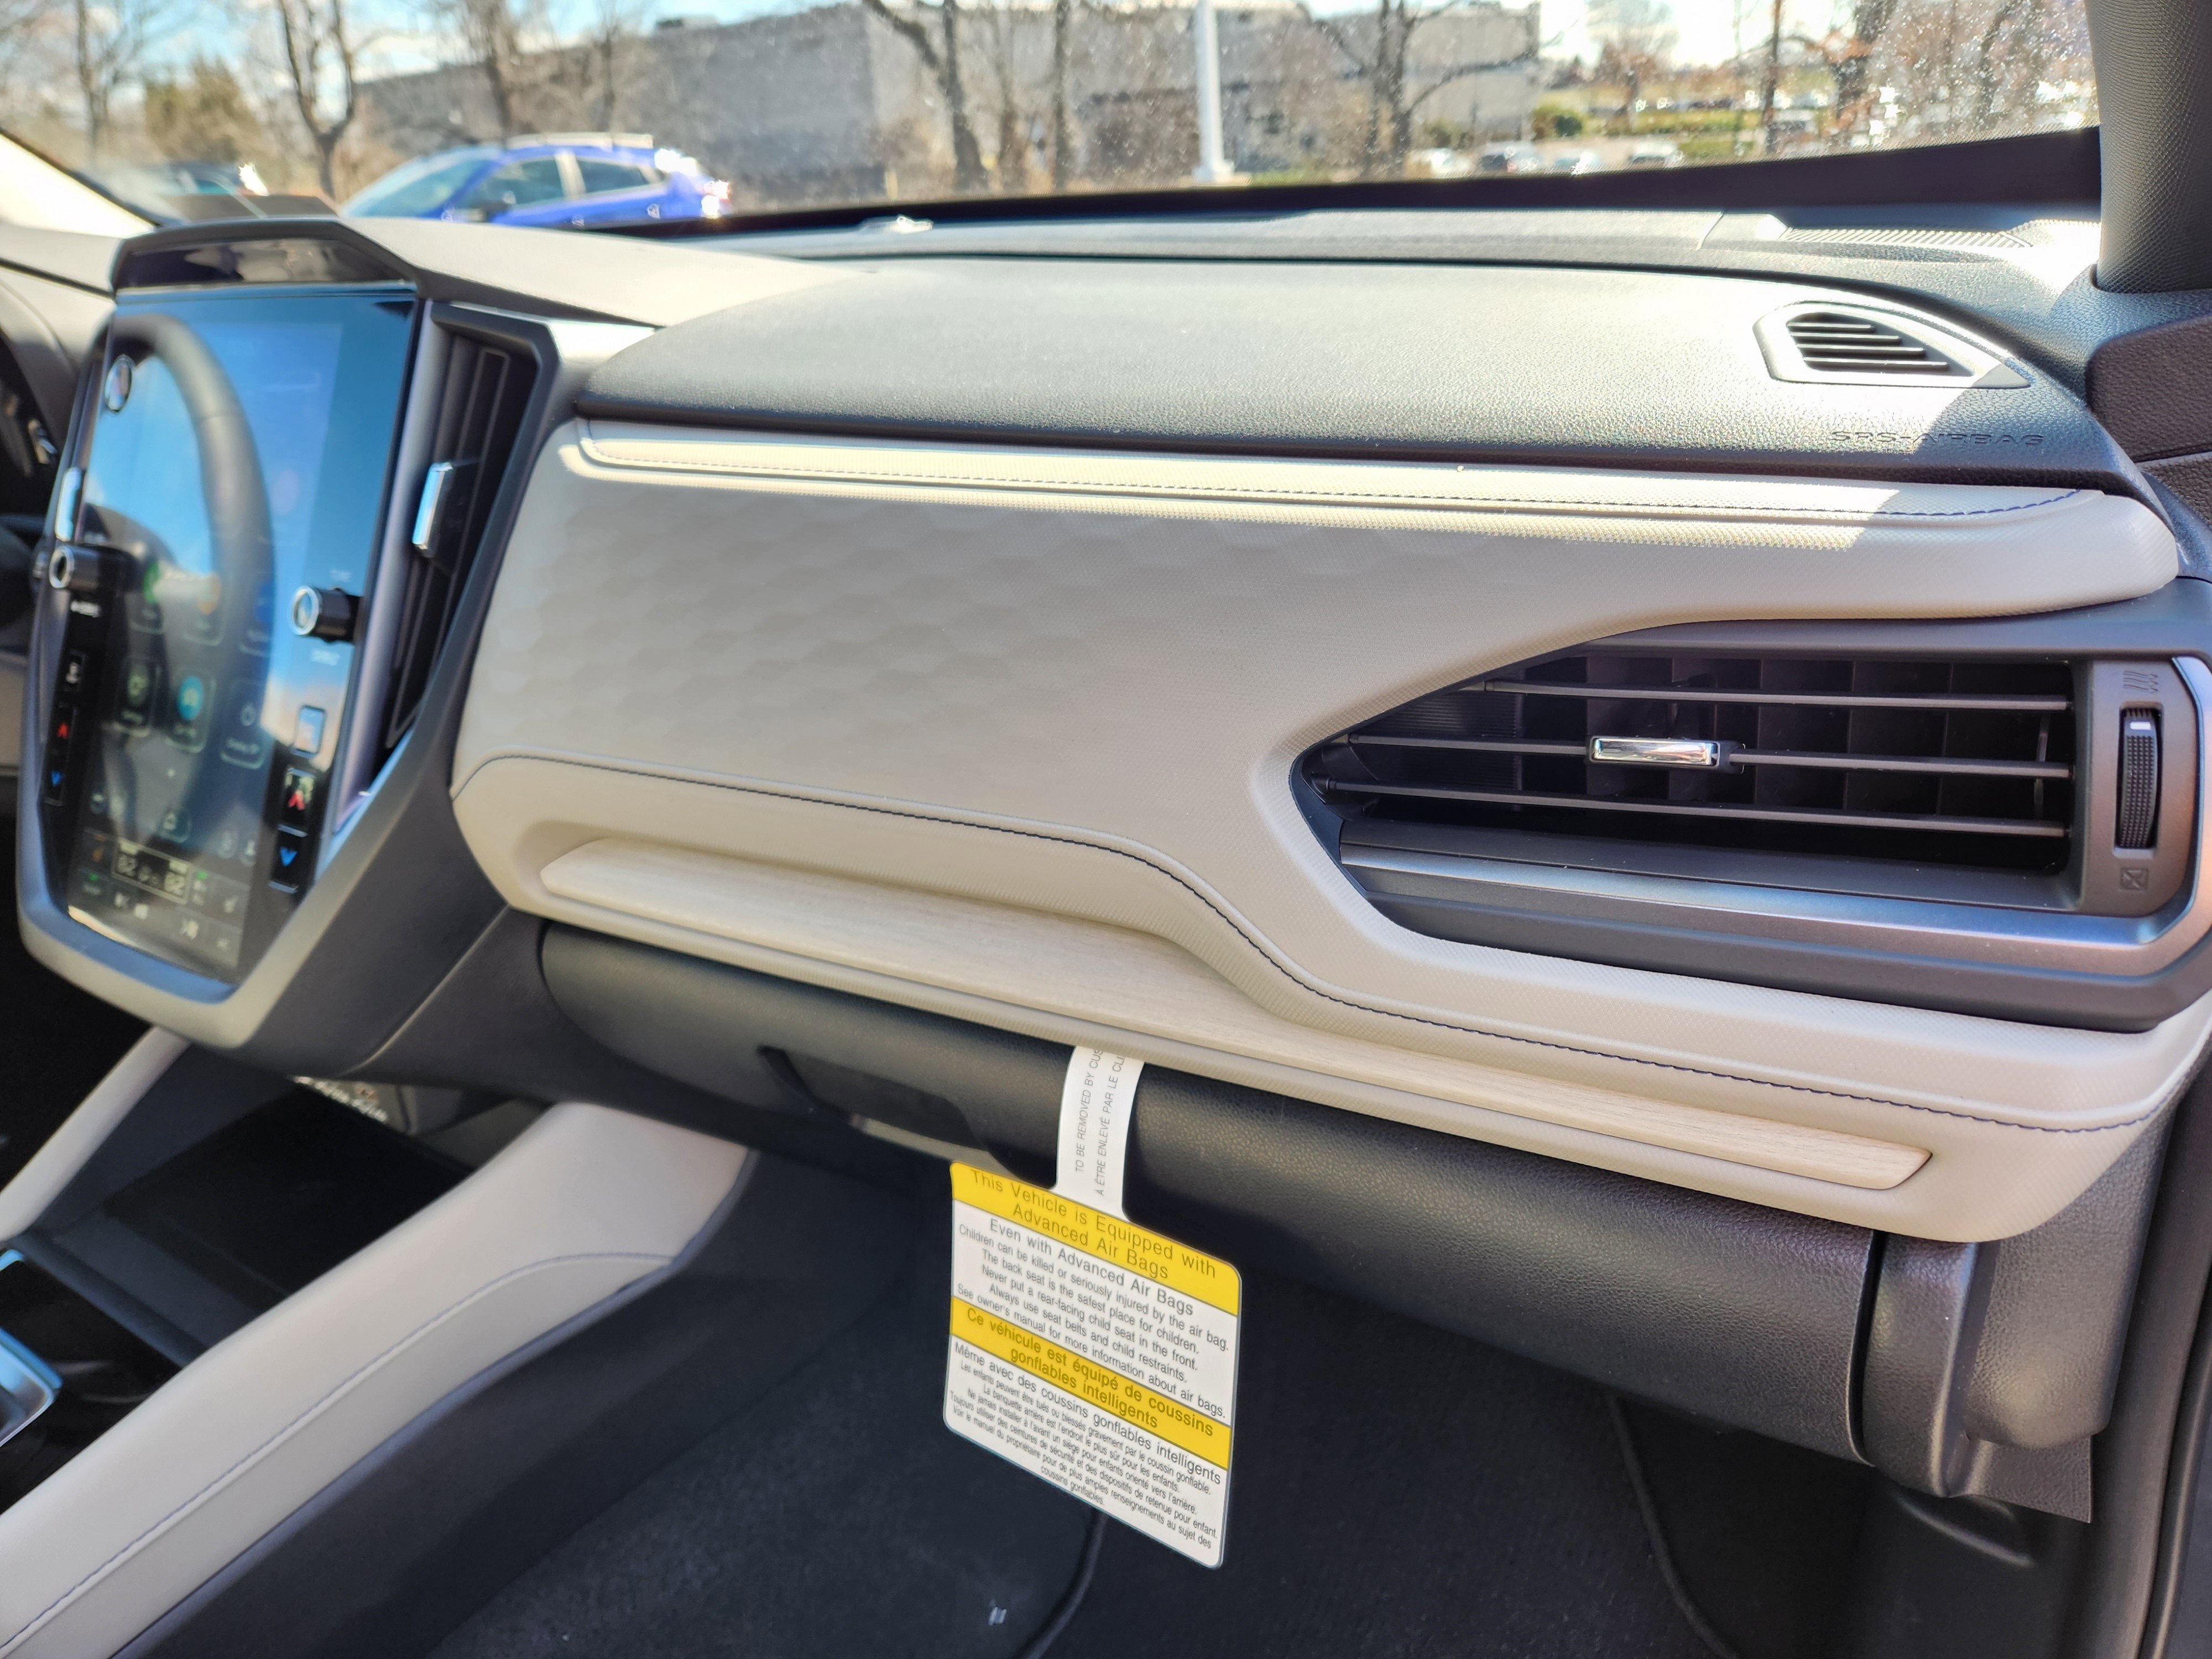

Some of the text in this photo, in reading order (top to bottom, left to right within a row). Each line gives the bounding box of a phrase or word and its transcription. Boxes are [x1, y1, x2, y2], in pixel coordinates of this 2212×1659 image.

[1077, 1089, 1091, 1140] REMOVED
[1084, 1072, 1094, 1086] BY
[1103, 1092, 1114, 1113] PAR
[1108, 1076, 1118, 1089] LE
[1075, 1160, 1084, 1172] TO
[1076, 1142, 1085, 1157] BE
[1094, 1159, 1106, 1186] ÊTRE
[1098, 1116, 1110, 1156] ENLEVÉ
[972, 1171, 1215, 1277] This Vehicle is Equipped with
[1013, 1203, 1167, 1279] Advanced Air Bags
[959, 1223, 1229, 1350] Children can be killed or seriously injured by the air bag.
[982, 1248, 1199, 1354] The back seat is the safest place for children.
[990, 1218, 1193, 1315] Even with Advanced Air Bags
[958, 1283, 1225, 1418] See owner's manual for more information about air bags.
[982, 1264, 1198, 1370] Never put a rear-facing child seat in the front.
[989, 1284, 1187, 1383] Always use seat belts and child restraints.
[967, 1307, 1213, 1436] Ce véhicule est équipé de coussins
[1011, 1348, 1157, 1428] gonflables intelligents
[989, 1361, 1013, 1380] avec
[1018, 1375, 1036, 1392] des
[1041, 1387, 1088, 1418] coussins
[1093, 1413, 1151, 1449] gonflables
[1156, 1442, 1220, 1484] intelligents
